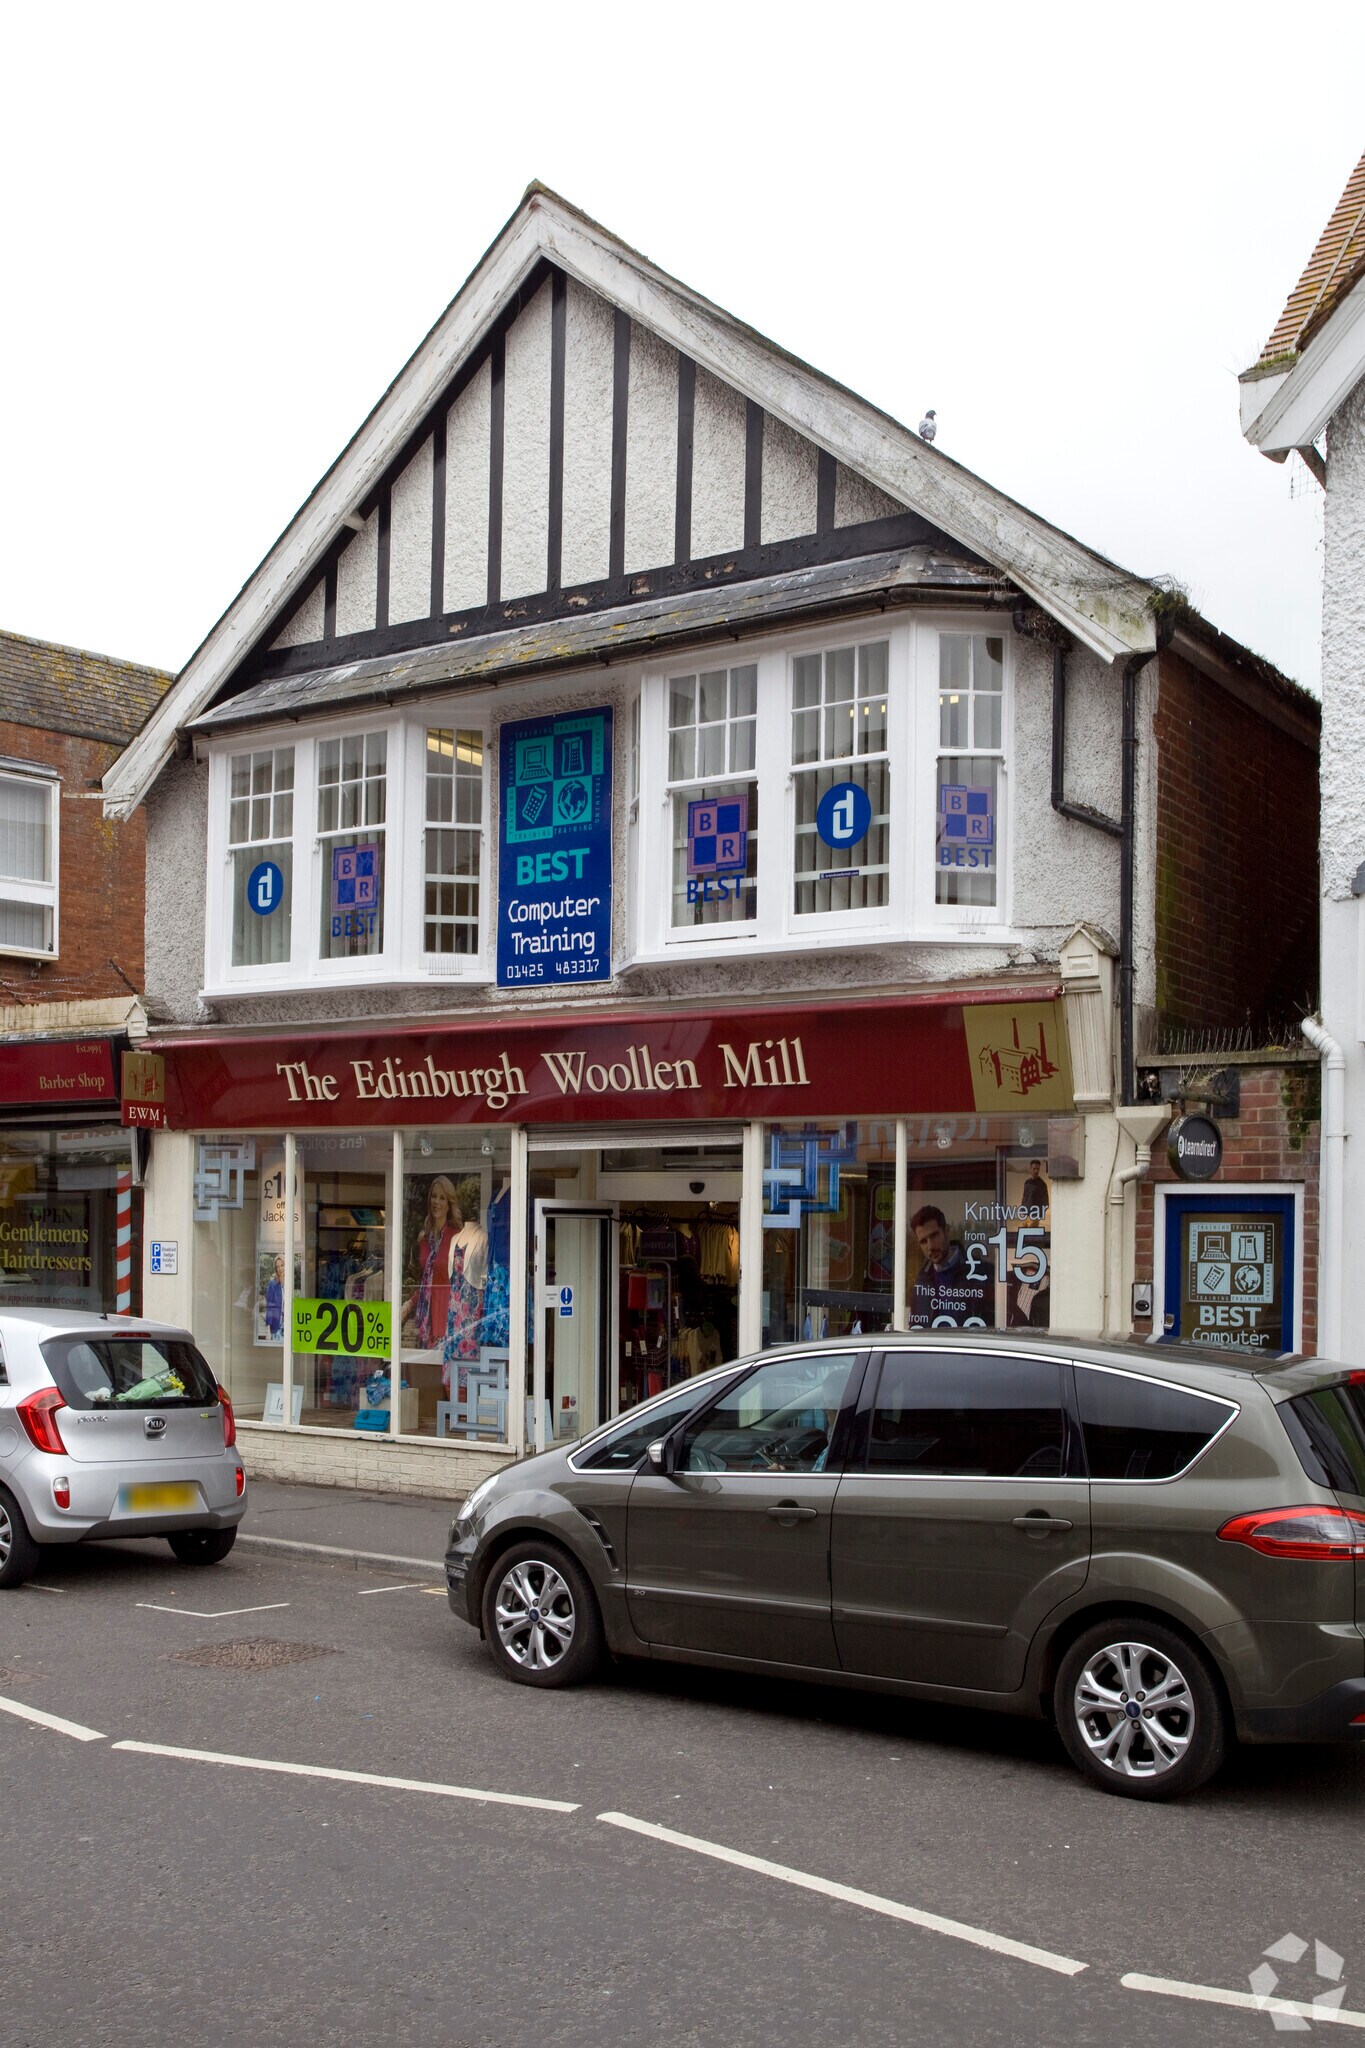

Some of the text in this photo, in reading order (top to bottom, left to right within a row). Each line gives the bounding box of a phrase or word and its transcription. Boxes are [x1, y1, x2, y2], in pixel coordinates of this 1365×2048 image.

[951, 795, 962, 810] B
[700, 813, 712, 832] B
[972, 819, 982, 834] R
[722, 839, 735, 858] R
[940, 846, 992, 868] BEST
[342, 858, 352, 875] B
[516, 848, 590, 886] BEST
[359, 881, 369, 898] R
[686, 874, 745, 904] BEST
[507, 895, 600, 926] Computer
[331, 912, 377, 938] BEST
[511, 926, 595, 956] Training
[506, 958, 600, 979] 01425 483317
[276, 1036, 811, 1109] The Edinburgh Woollen Mill
[39, 1072, 105, 1093] Barber Shop
[128, 1106, 160, 1121] EWM
[262, 1210, 299, 1223] Jacks
[965, 1201, 1049, 1221] Knitwear
[964, 1231, 986, 1241] from
[0, 1248, 92, 1272] Hairdressers
[965, 1226, 1048, 1284] £15
[914, 1284, 984, 1299] This Seasons
[930, 1299, 967, 1311] Chinos
[297, 1312, 312, 1325] UP
[908, 1313, 929, 1323] from
[1200, 1305, 1262, 1327] BEST
[297, 1329, 312, 1343] TO
[367, 1336, 390, 1350] OFF
[150, 1419, 165, 1428] KIA
